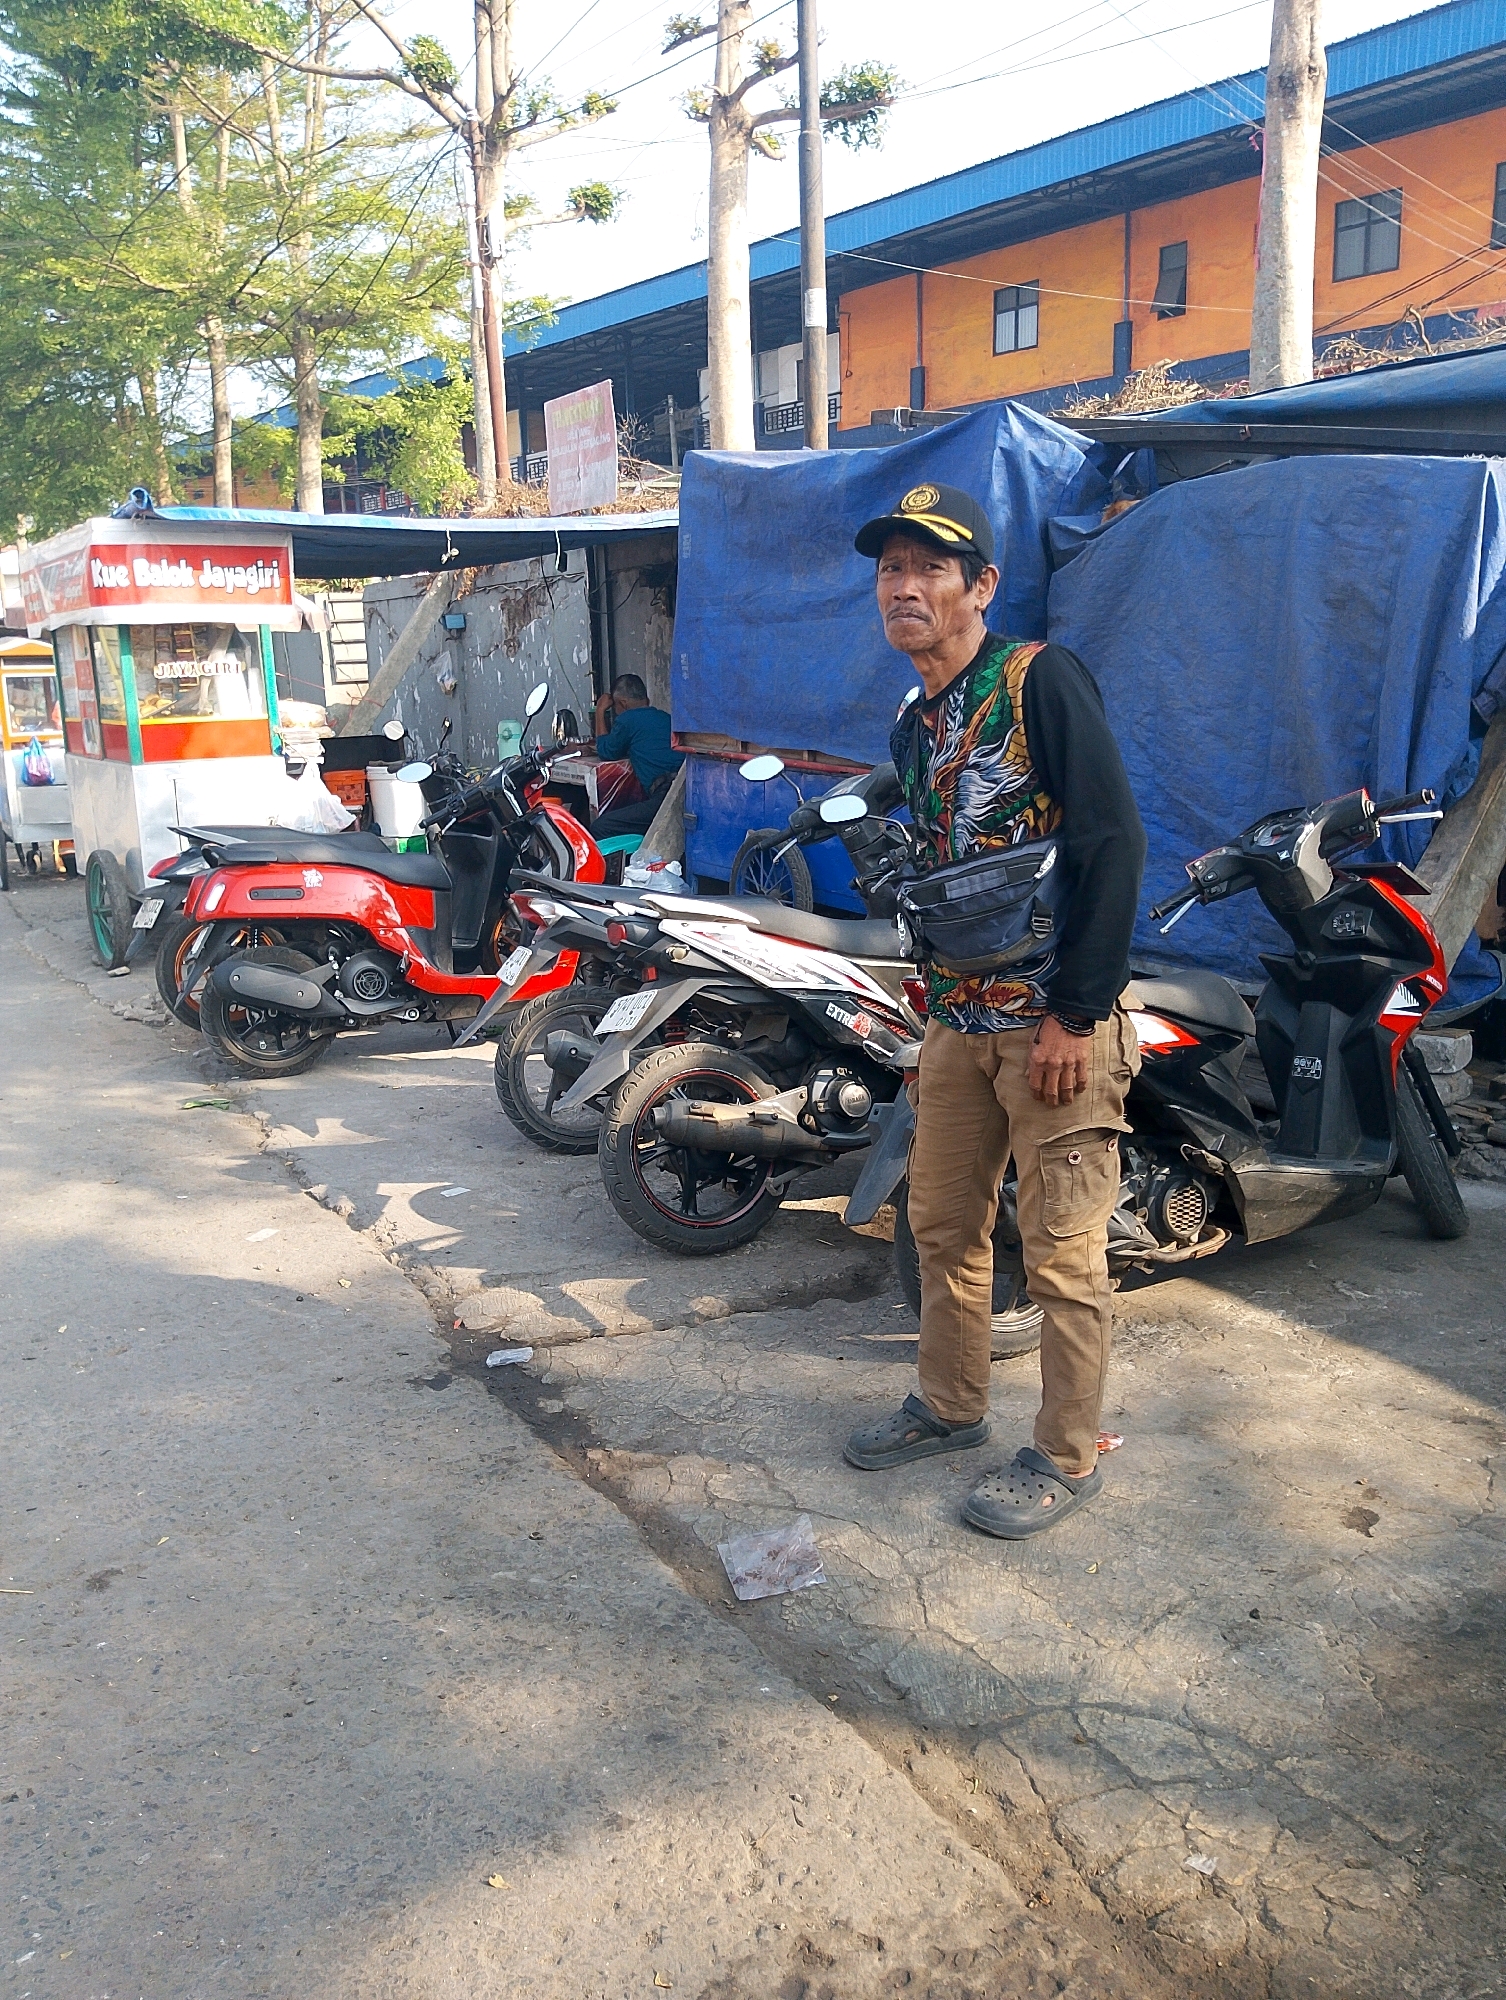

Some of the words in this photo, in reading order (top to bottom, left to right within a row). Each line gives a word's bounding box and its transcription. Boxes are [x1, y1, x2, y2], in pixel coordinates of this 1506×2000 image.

[90, 557, 130, 588] Kue
[132, 556, 195, 588] Balok
[198, 558, 281, 595] Jayagiri
[156, 662, 240, 677] JAYAGIRI
